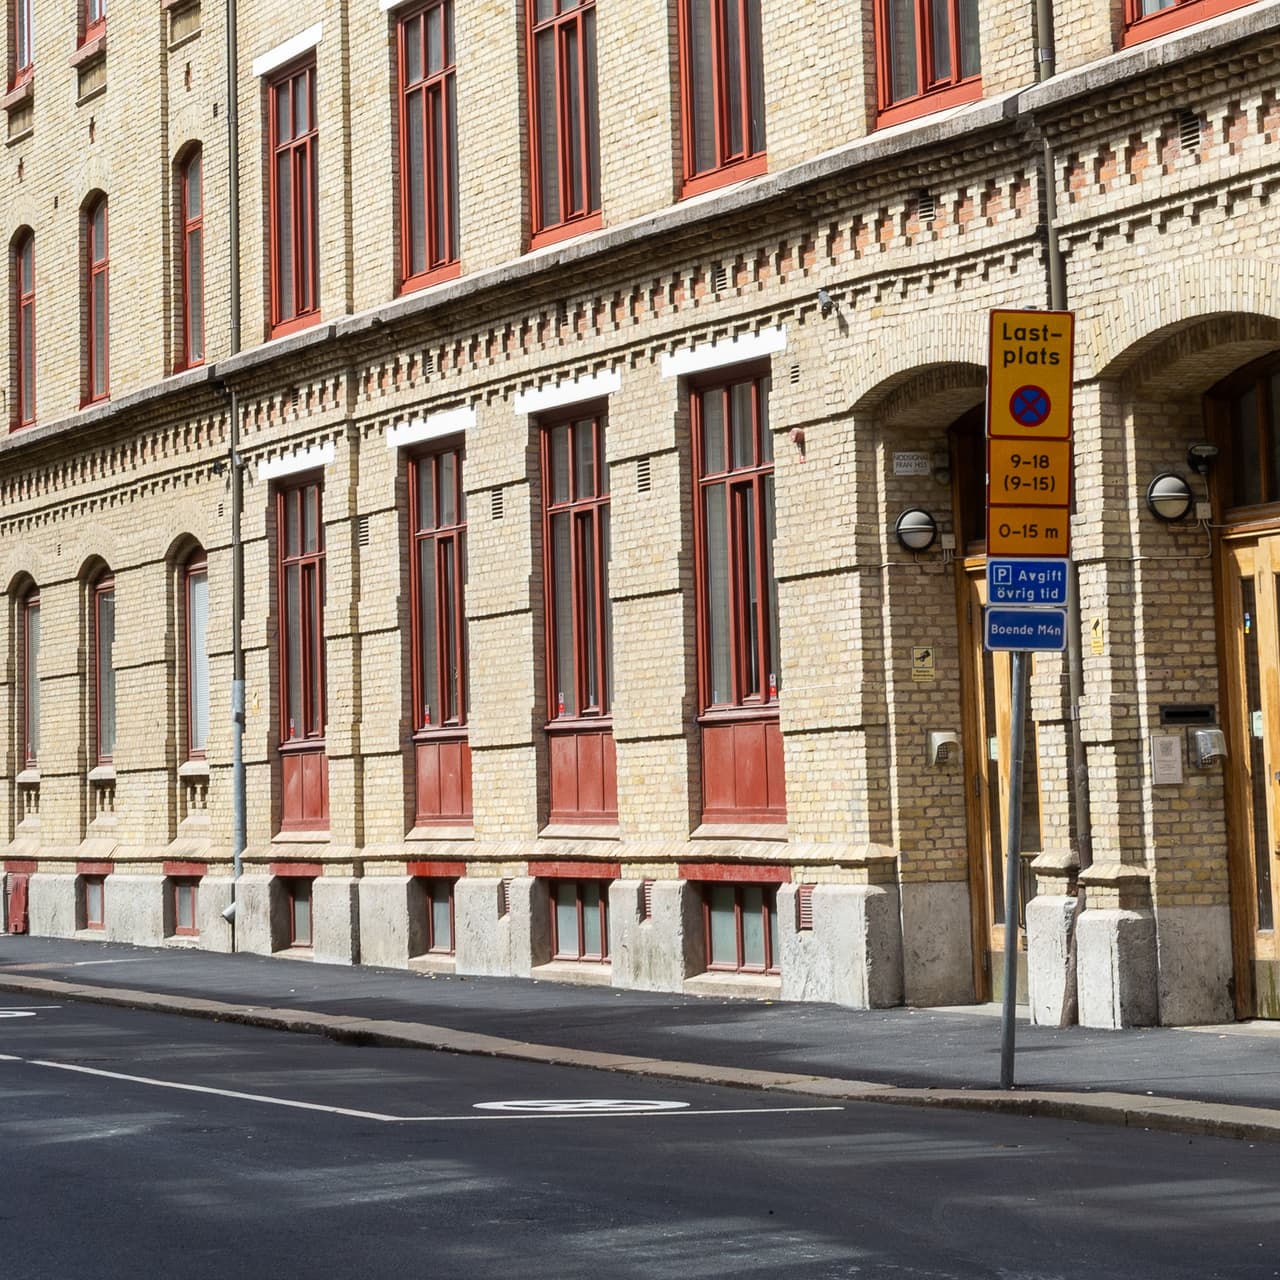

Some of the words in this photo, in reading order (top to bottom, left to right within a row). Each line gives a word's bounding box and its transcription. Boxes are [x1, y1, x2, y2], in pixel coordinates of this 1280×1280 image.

[1003, 322, 1062, 342] Last-
[1003, 346, 1060, 368] plats
[1010, 454, 1050, 469] 9-18
[1004, 475, 1055, 493] (9-15)
[999, 523, 1038, 538] 0-15
[1045, 527, 1058, 538] m
[998, 568, 1007, 581] P
[1018, 569, 1062, 584] Avgift
[997, 587, 1035, 601] övrig
[1040, 587, 1059, 599] tid
[991, 624, 1034, 635] Boende
[1037, 624, 1061, 636] M4n
